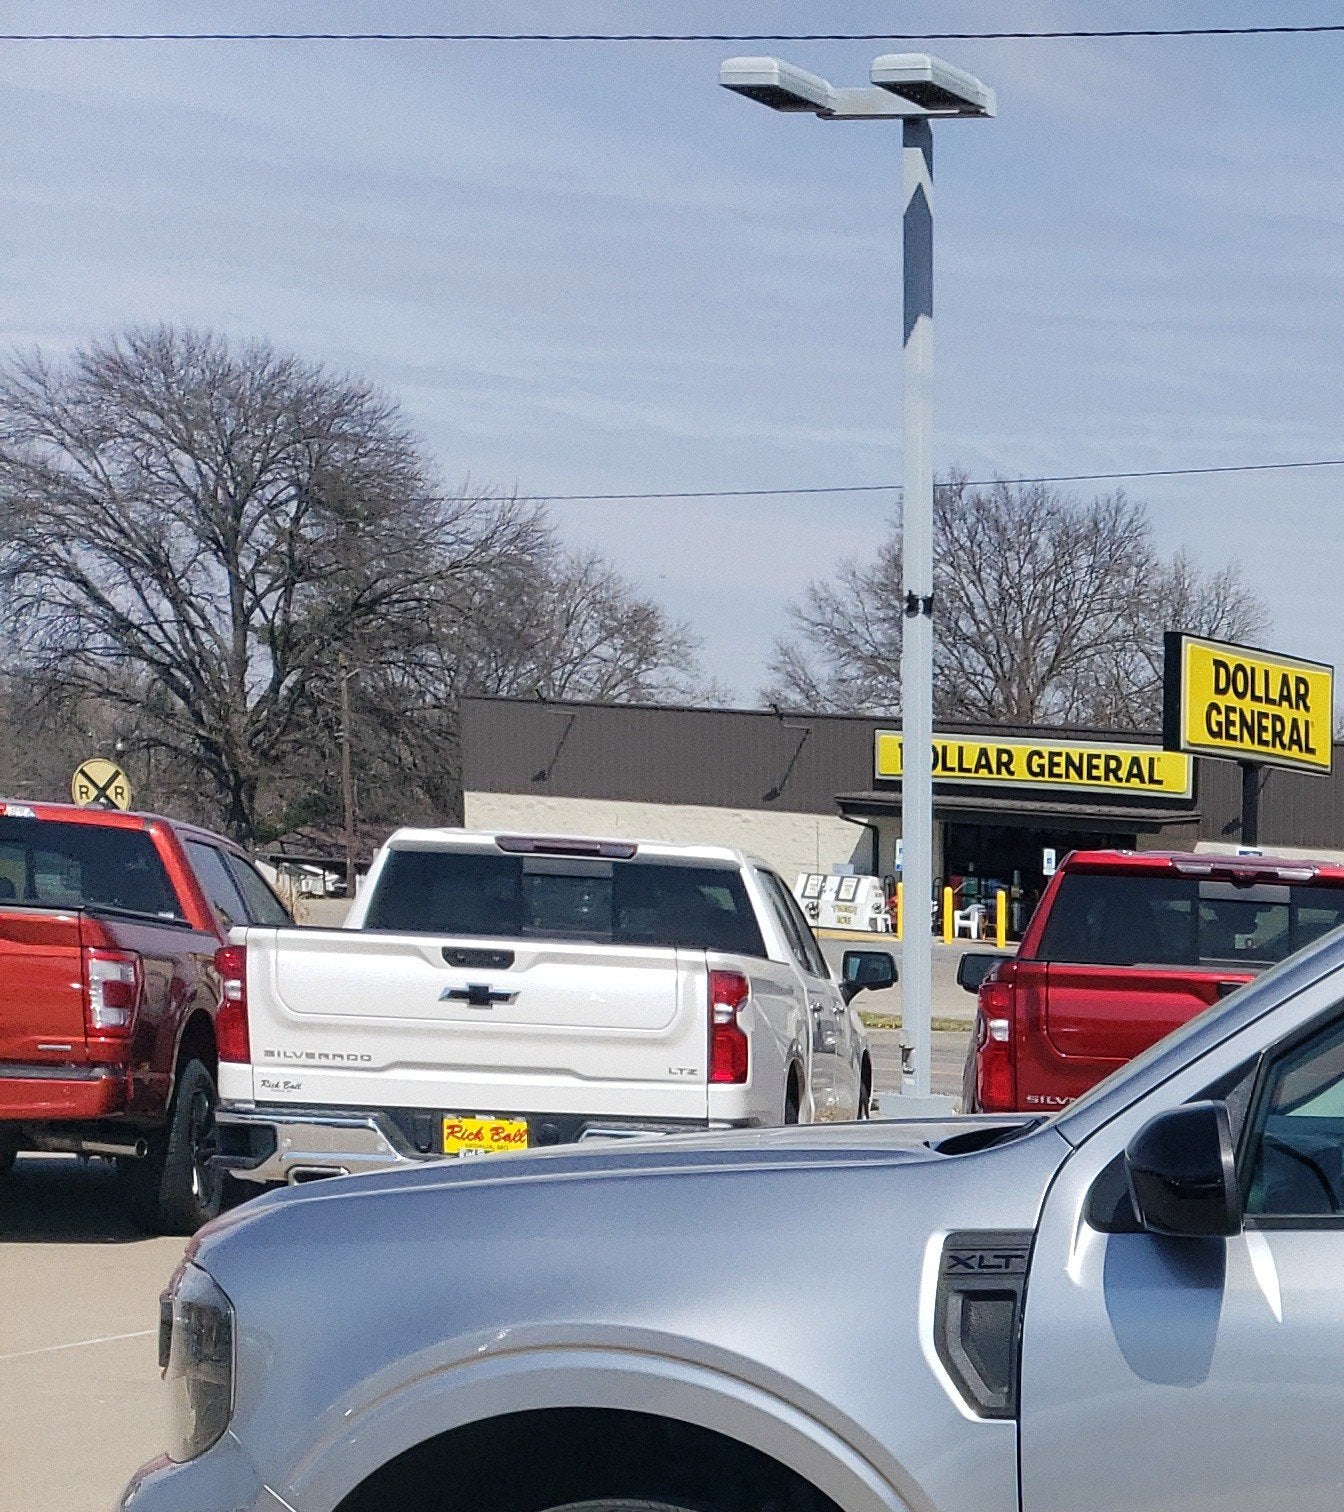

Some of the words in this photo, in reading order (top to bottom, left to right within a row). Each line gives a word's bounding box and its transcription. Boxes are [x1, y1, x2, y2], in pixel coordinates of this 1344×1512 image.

[1212, 657, 1311, 713] DOLLAR
[1205, 702, 1317, 755] GENERAL
[898, 742, 1016, 777] LLAR
[1025, 749, 1164, 786] GENERAL
[263, 1049, 373, 1062] SILVERADO
[445, 1124, 485, 1142] Rick
[947, 1254, 1026, 1270] XLT
